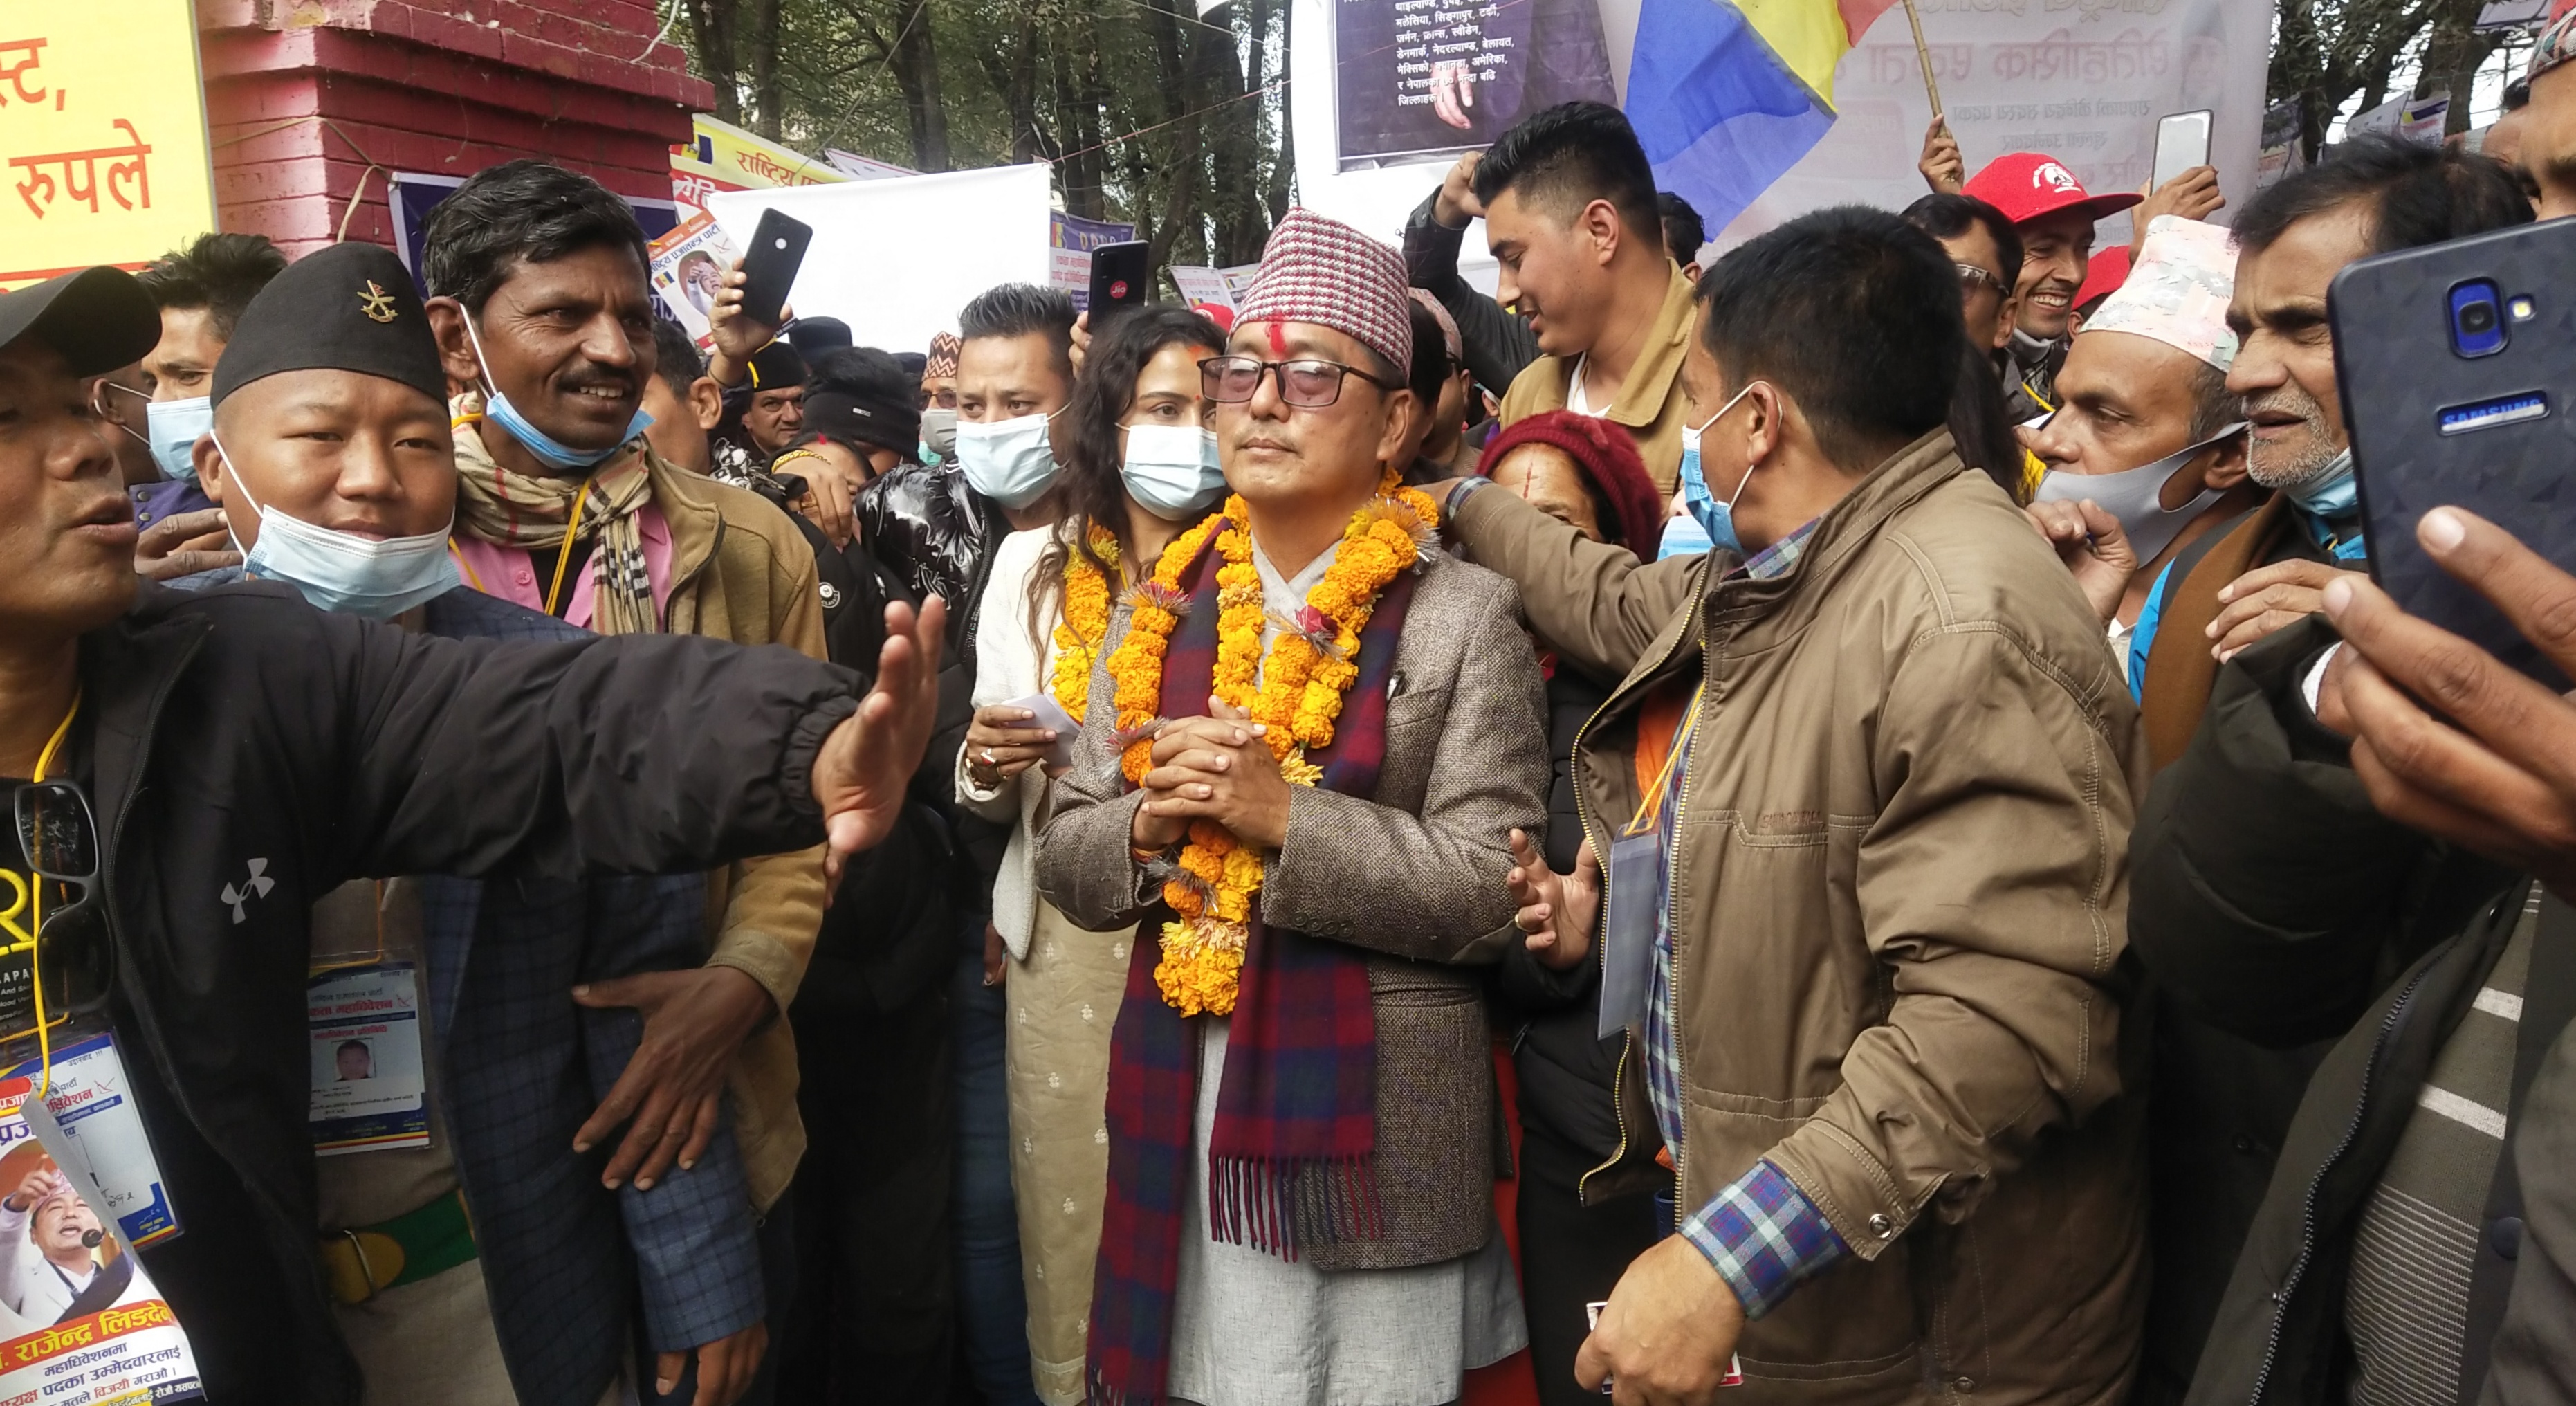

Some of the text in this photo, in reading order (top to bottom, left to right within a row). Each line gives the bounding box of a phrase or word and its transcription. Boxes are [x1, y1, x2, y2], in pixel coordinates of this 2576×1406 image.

[1395, 14, 1432, 28] मलेसिया,
[1478, 3, 1500, 17] टर्की,
[1395, 30, 1420, 44] जर्मन,
[1451, 23, 1482, 37] स्वीडेन,
[1396, 37, 1514, 59] डेनमार्क, नेदरल्याण्ड, बेलायत,
[1396, 60, 1433, 75] मेक्सिको,
[1471, 52, 1508, 66] अमेरिका,
[1397, 81, 1404, 91] र
[1406, 77, 1440, 90] नेपालका
[8, 118, 152, 220] रुपले
[1112, 284, 1126, 294] Jio
[14, 1322, 93, 1362] राजेन्द्र
[42, 1373, 85, 1396] पदका
[89, 1344, 181, 1381] उम्मेदवारलाई
[43, 1342, 128, 1378] महाधिवेशनमा
[93, 1378, 130, 1399] विजयी
